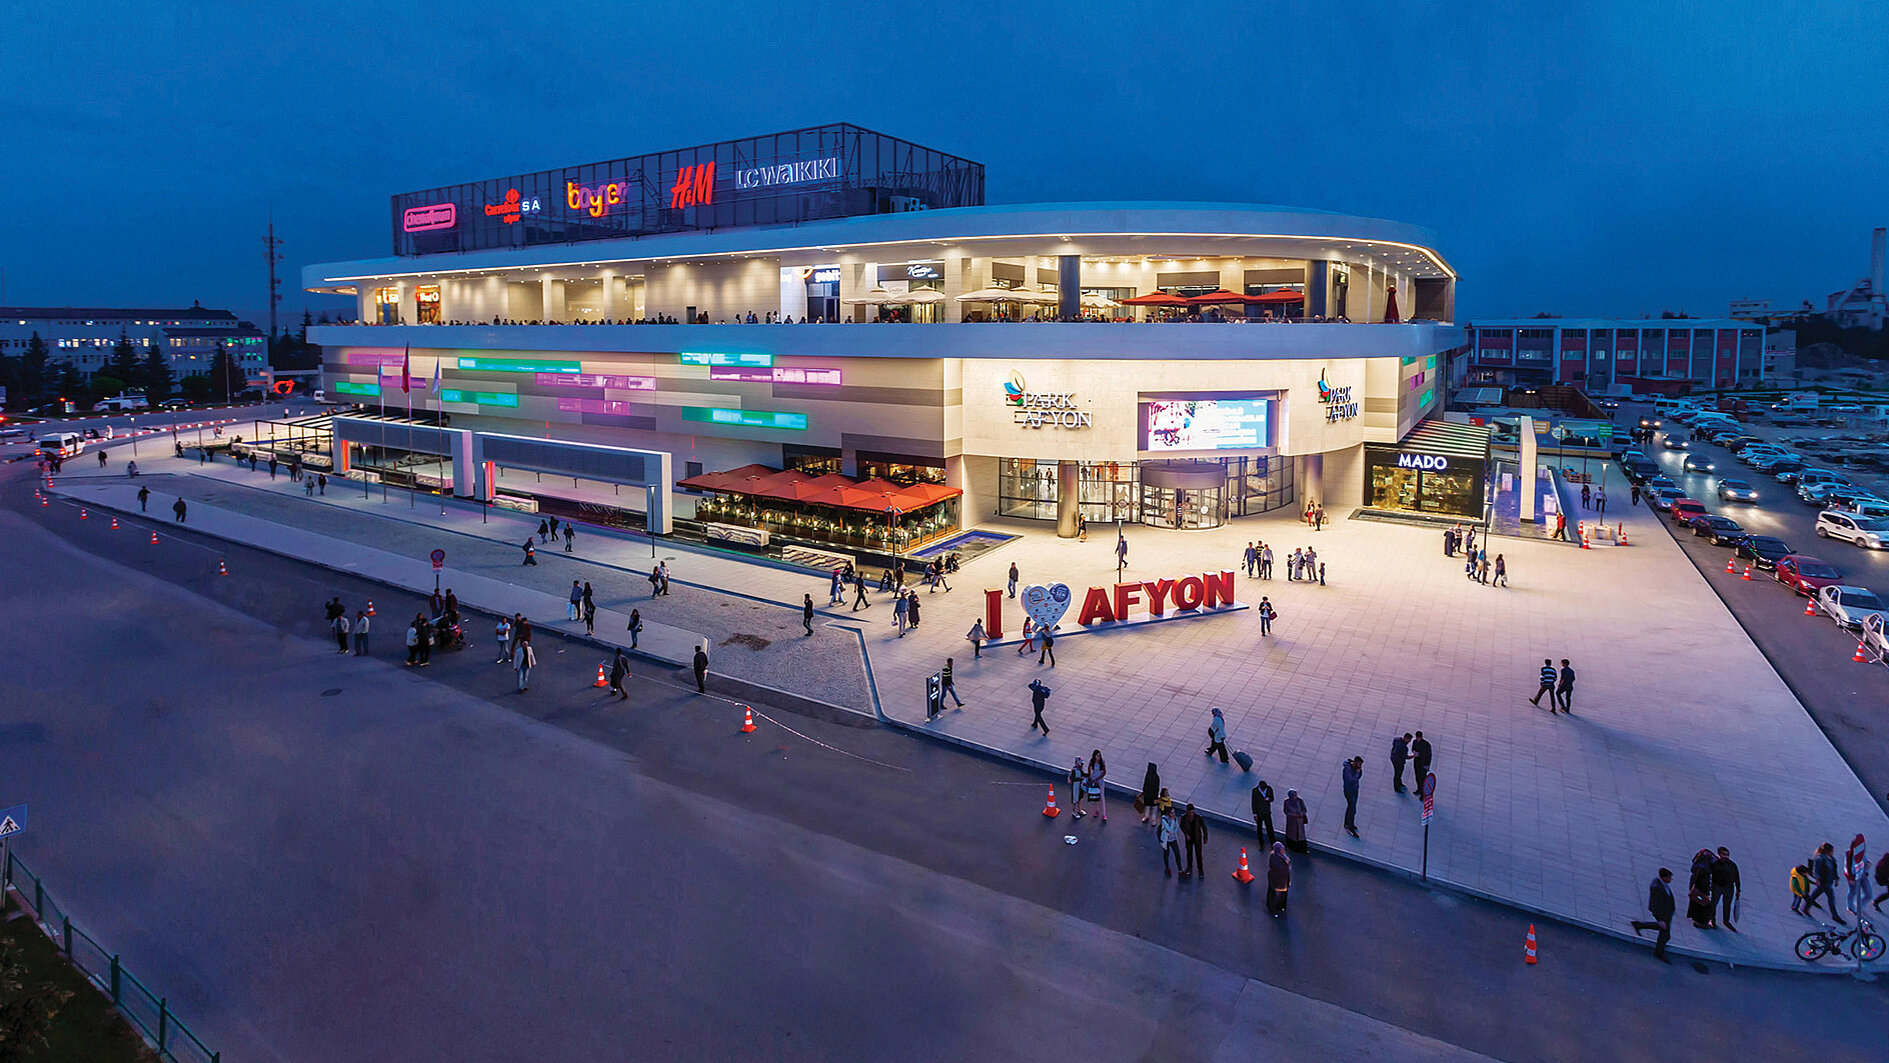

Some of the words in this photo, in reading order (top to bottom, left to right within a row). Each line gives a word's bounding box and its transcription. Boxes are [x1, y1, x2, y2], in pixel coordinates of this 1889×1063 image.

[671, 161, 714, 209] H&M
[736, 169, 759, 188] LC
[567, 181, 628, 217] boyner
[1022, 391, 1077, 409] PARK
[1328, 386, 1351, 404] PARK
[1021, 410, 1093, 428] AFYON
[1330, 402, 1358, 421] AFYON
[1398, 453, 1448, 470] MADO
[984, 588, 1003, 640] I
[1078, 569, 1235, 626] AFYON
